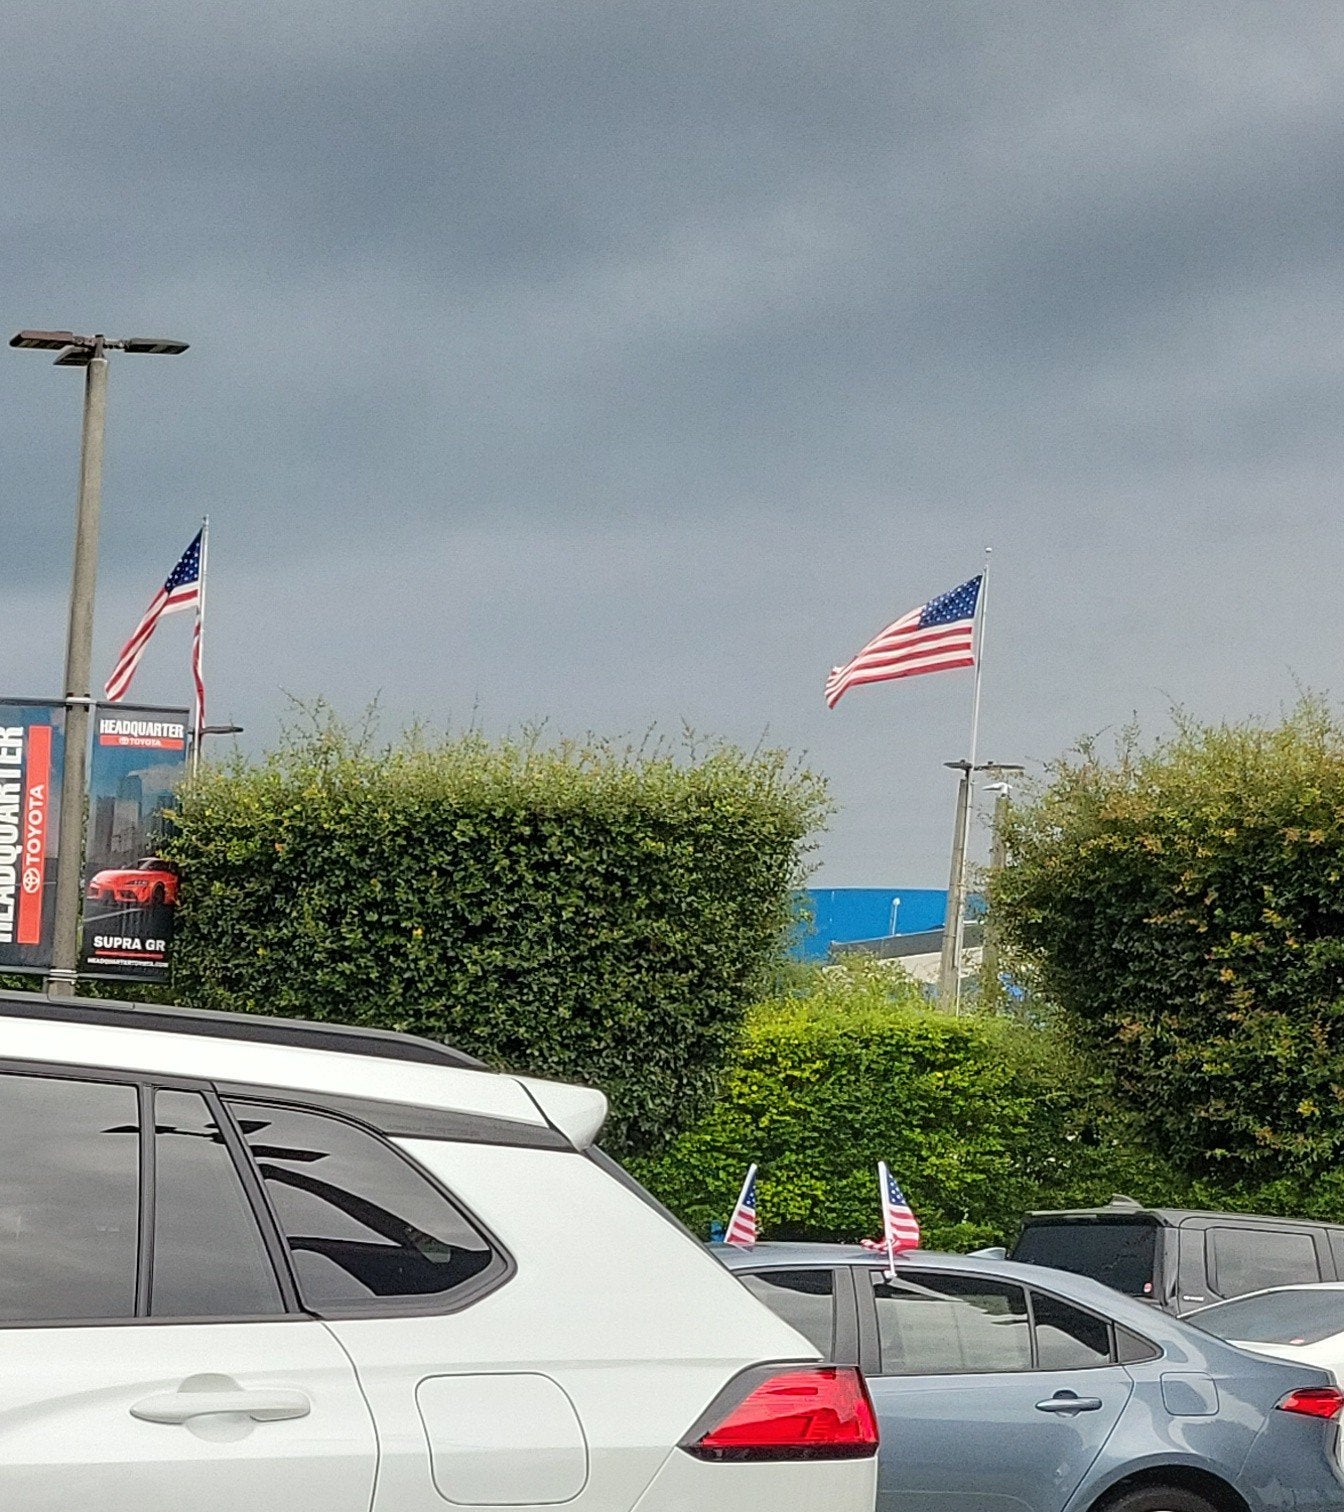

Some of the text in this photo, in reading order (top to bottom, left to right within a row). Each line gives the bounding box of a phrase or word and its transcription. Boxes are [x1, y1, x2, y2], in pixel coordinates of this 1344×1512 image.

[100, 719, 184, 738] HEADQUARTER
[26, 784, 44, 865] TOYOTA
[93, 935, 166, 952] SUPRA GR
